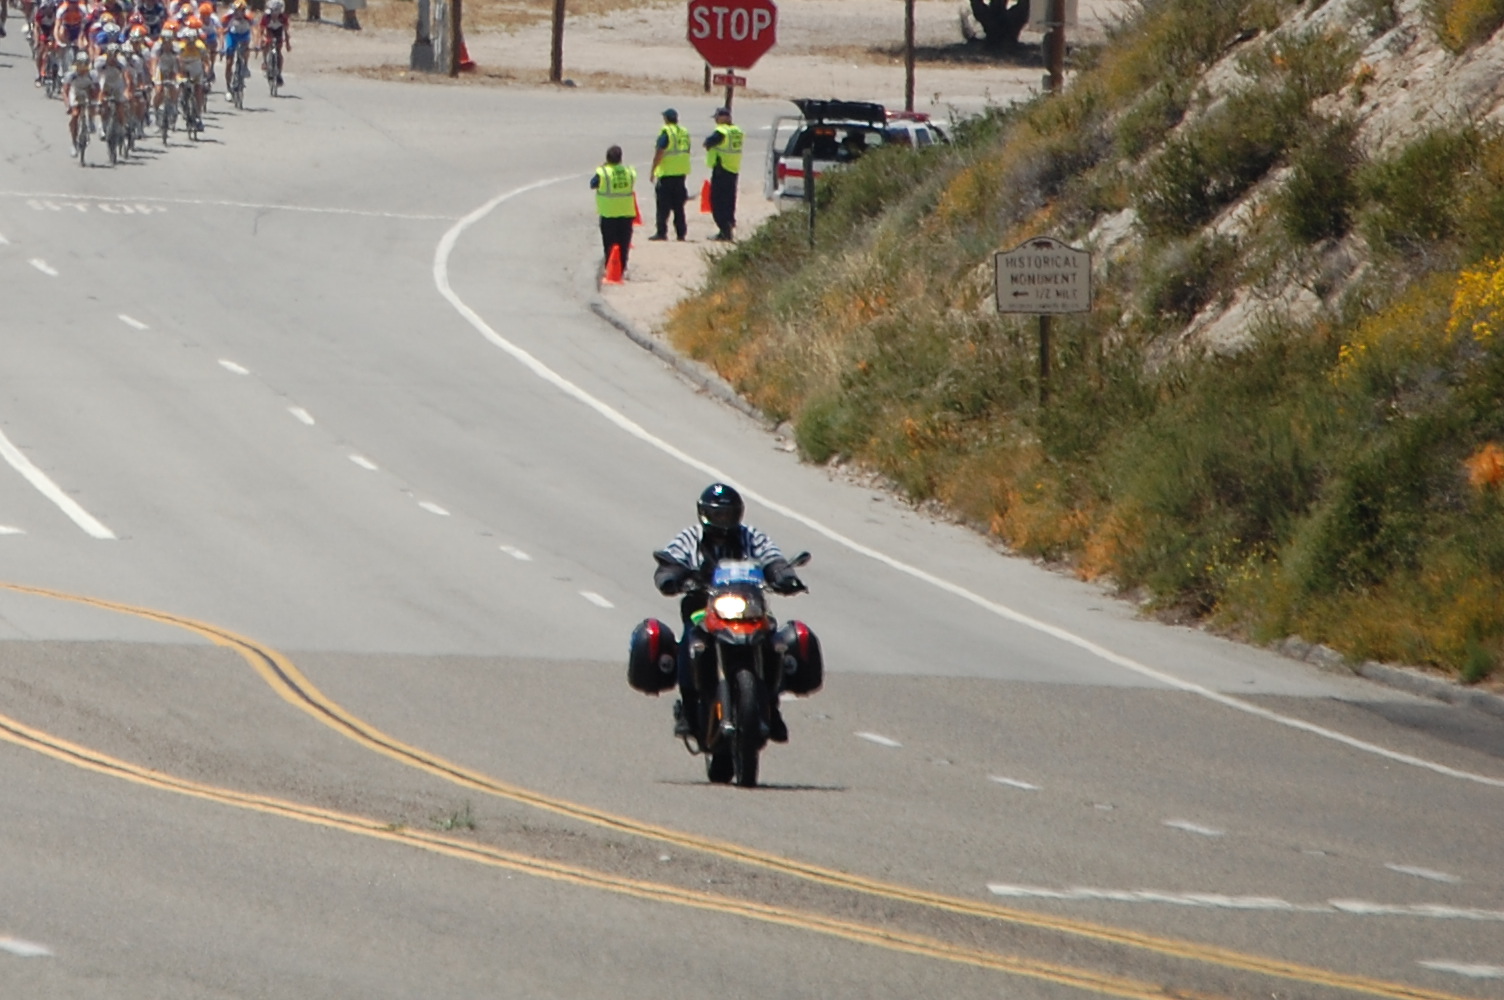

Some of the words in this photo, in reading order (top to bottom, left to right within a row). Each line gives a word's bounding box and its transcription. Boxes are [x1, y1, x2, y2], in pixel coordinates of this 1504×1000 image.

[692, 6, 771, 40] STOP
[1006, 256, 1078, 268] HISTORICAL
[1011, 273, 1077, 285] MONUMENT
[1036, 290, 1051, 299] 1/2
[1056, 289, 1077, 300] MILE
